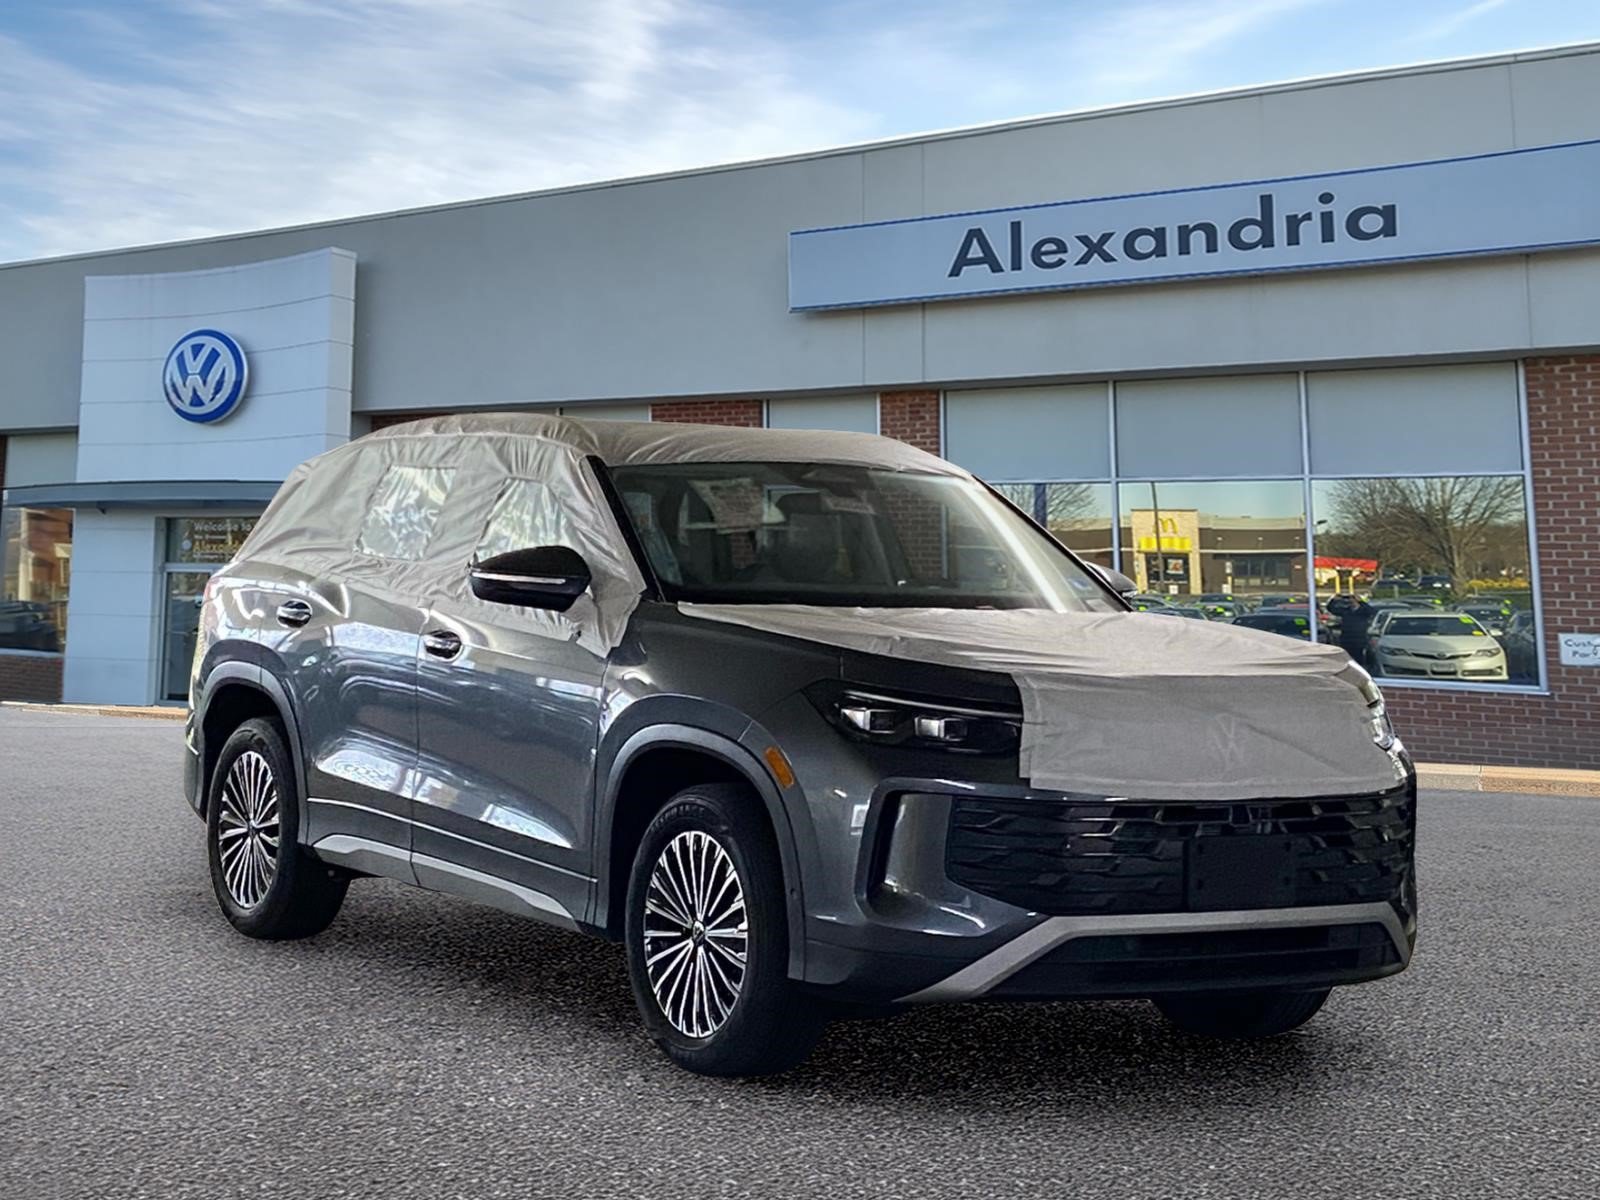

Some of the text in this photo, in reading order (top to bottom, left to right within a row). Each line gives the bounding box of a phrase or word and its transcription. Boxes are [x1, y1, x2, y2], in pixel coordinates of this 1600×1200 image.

[947, 191, 1398, 278] Alexandria
[165, 331, 242, 420] VW
[193, 521, 239, 532] Welcome
